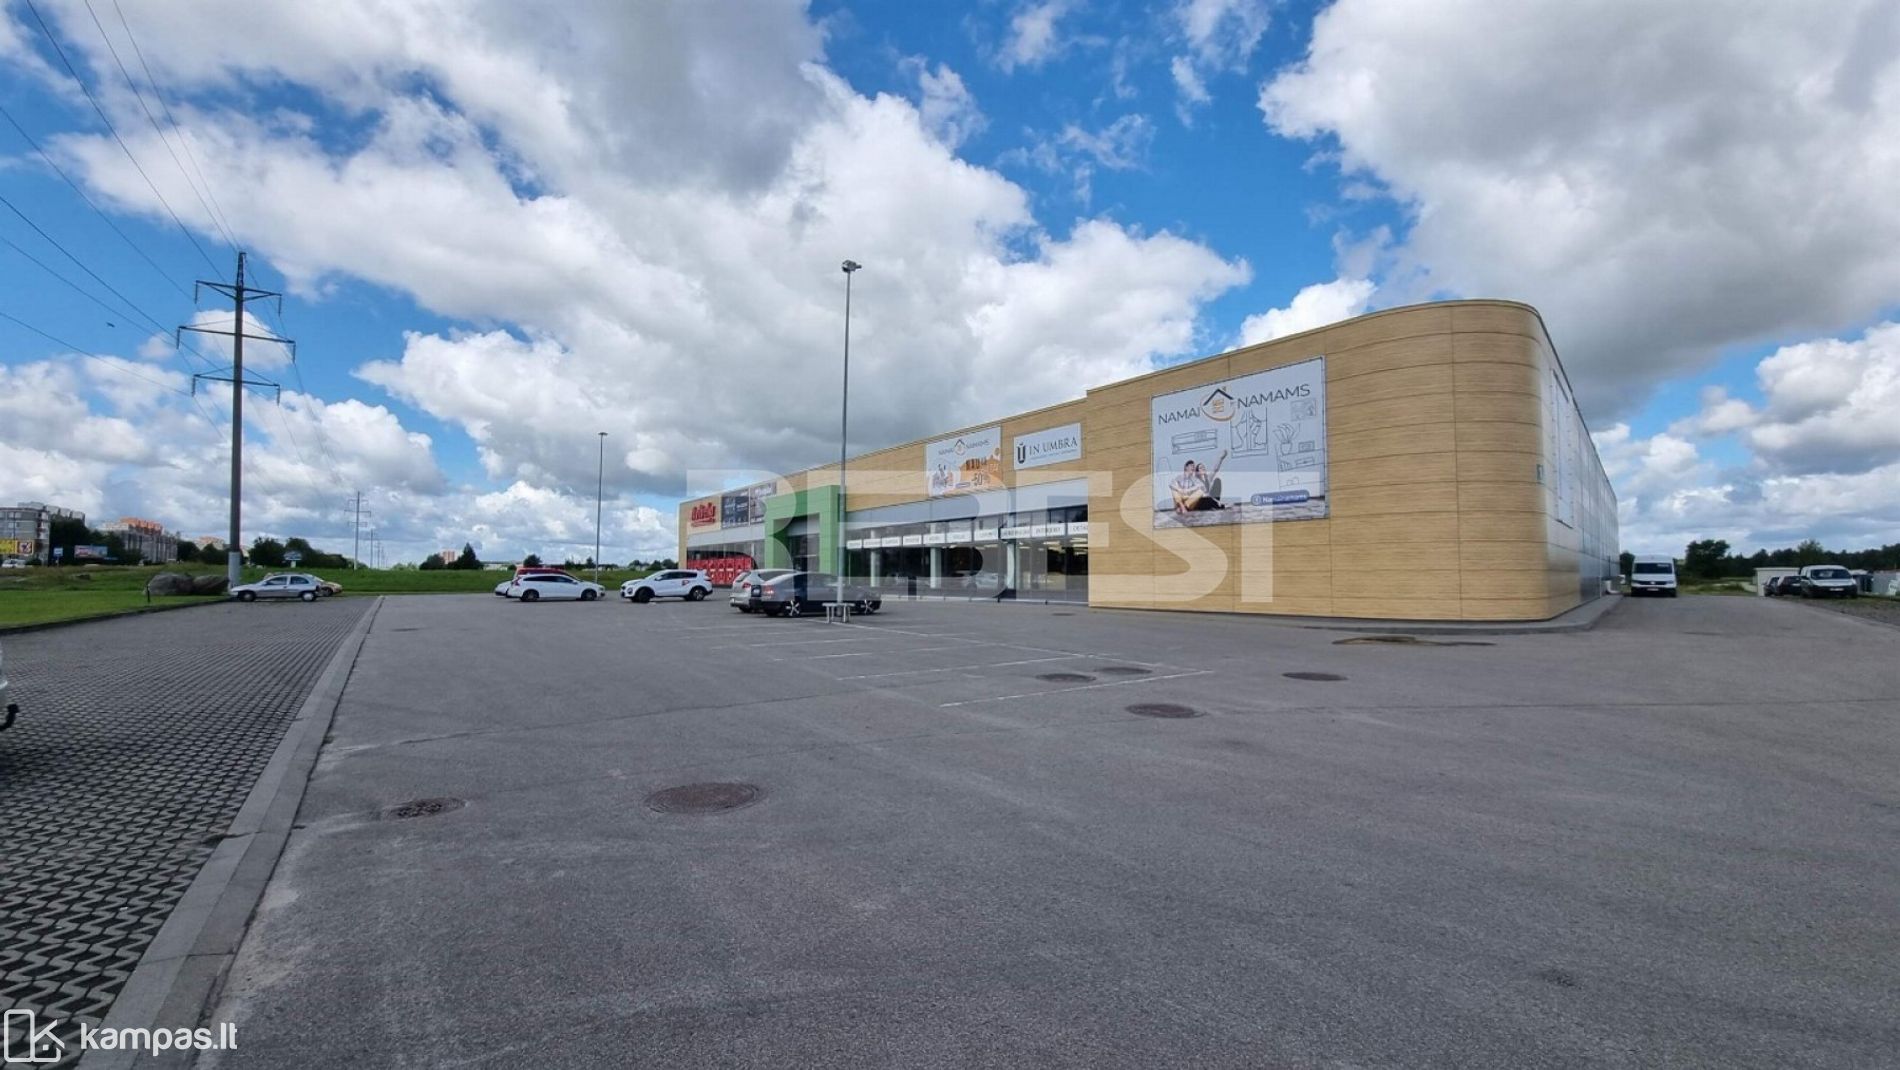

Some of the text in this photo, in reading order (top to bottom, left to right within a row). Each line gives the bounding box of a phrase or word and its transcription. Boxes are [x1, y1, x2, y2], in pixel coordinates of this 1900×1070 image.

[1158, 383, 1311, 425] NAMAI NAMAMS
[1029, 443, 1041, 456] IN
[1043, 436, 1078, 453] UMBRA
